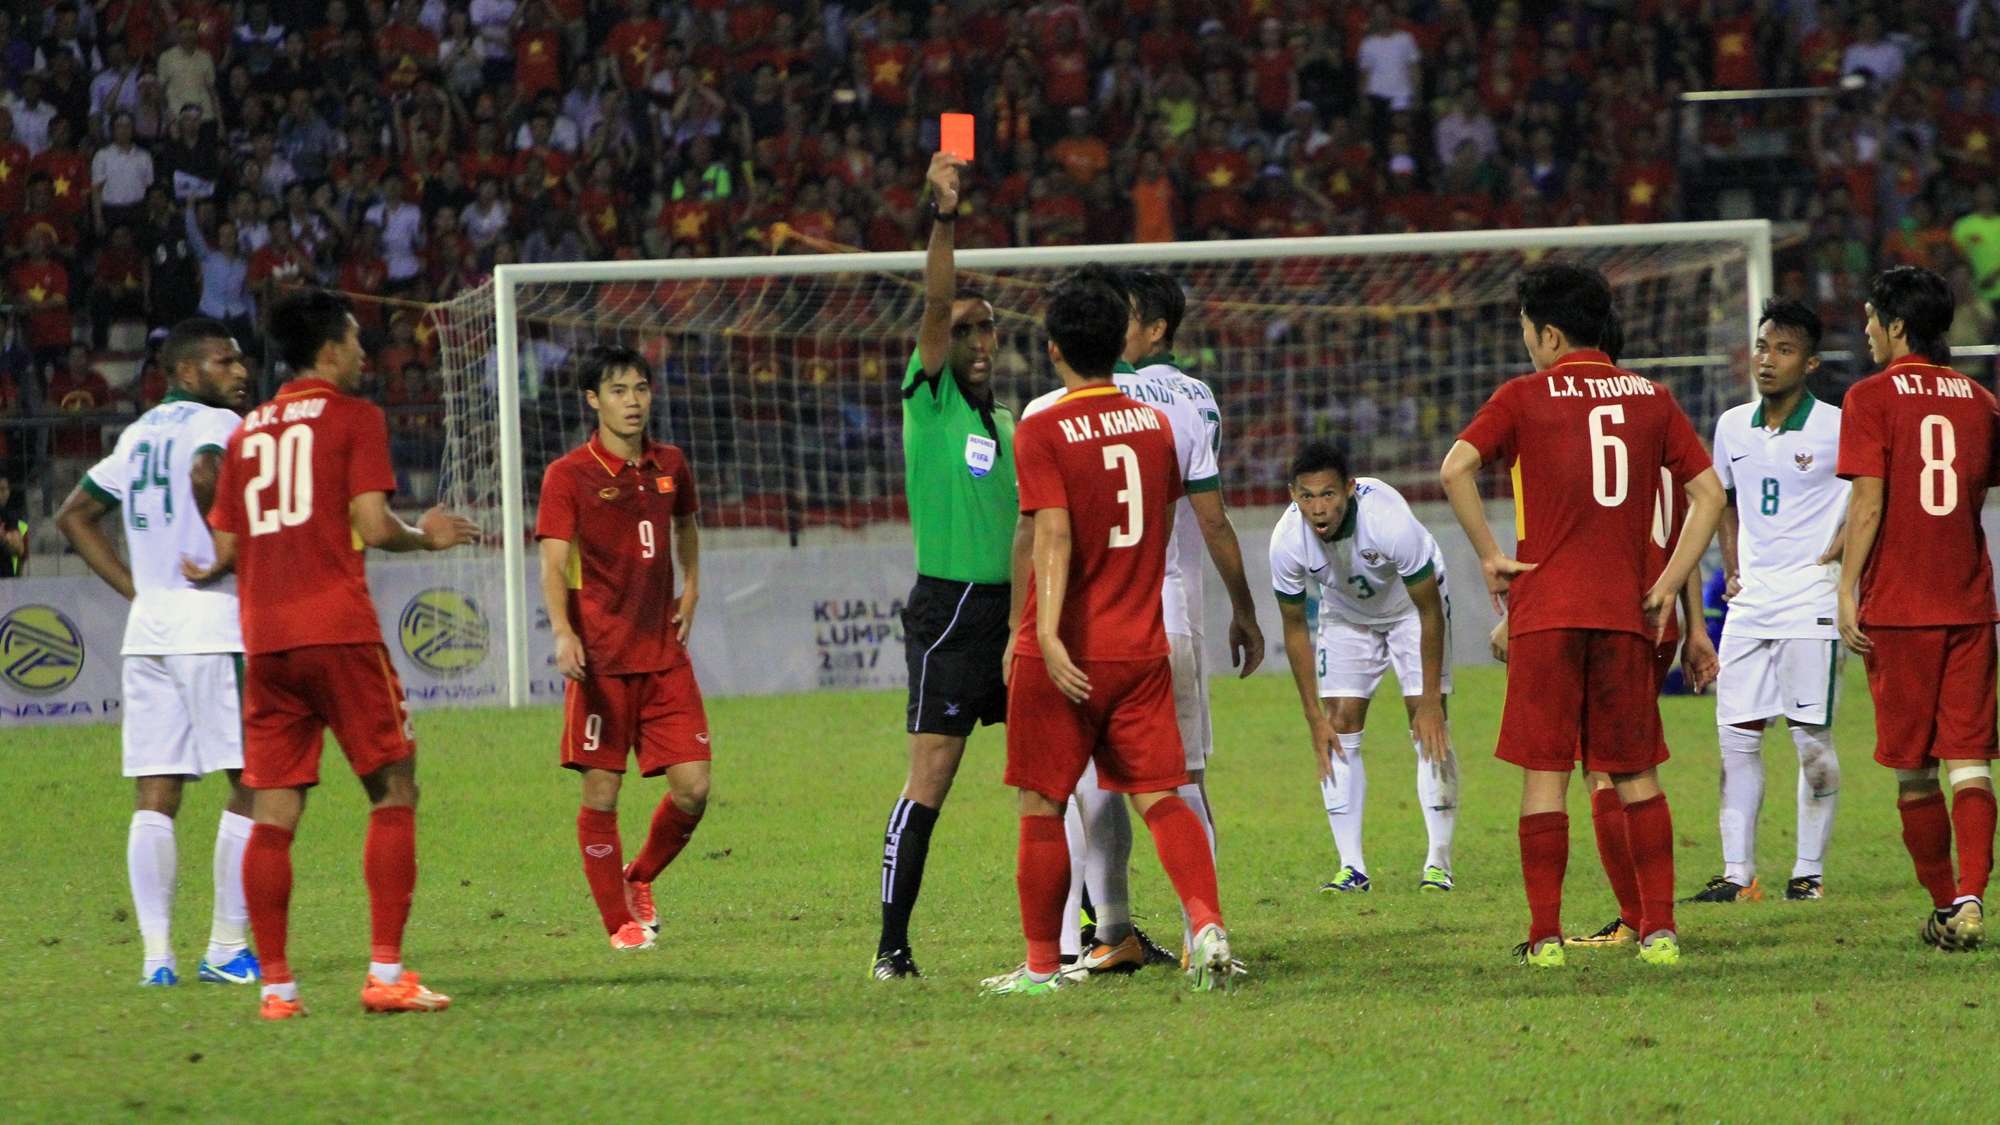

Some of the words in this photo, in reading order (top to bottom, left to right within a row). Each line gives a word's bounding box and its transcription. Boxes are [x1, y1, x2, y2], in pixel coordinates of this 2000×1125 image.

[1547, 376, 1583, 397] L.X.
[1584, 375, 1655, 398] TRUONG
[1892, 374, 1932, 395] N.T.
[1937, 378, 1973, 398] ANH
[1058, 415, 1100, 443] H.V.
[1099, 407, 1160, 436] KHANH
[1589, 404, 1629, 507] 6
[1920, 415, 1958, 516] 8
[129, 438, 174, 531] 24
[241, 423, 313, 536] 20
[1102, 443, 1144, 548] 3
[1761, 477, 1780, 516] 8
[638, 520, 655, 559] 9
[1348, 575, 1376, 599] 3
[814, 599, 903, 621] KUALA
[816, 624, 907, 645] LUMPU
[1318, 648, 1328, 677] 3
[583, 714, 601, 751] 9
[883, 832, 901, 870] FBT
